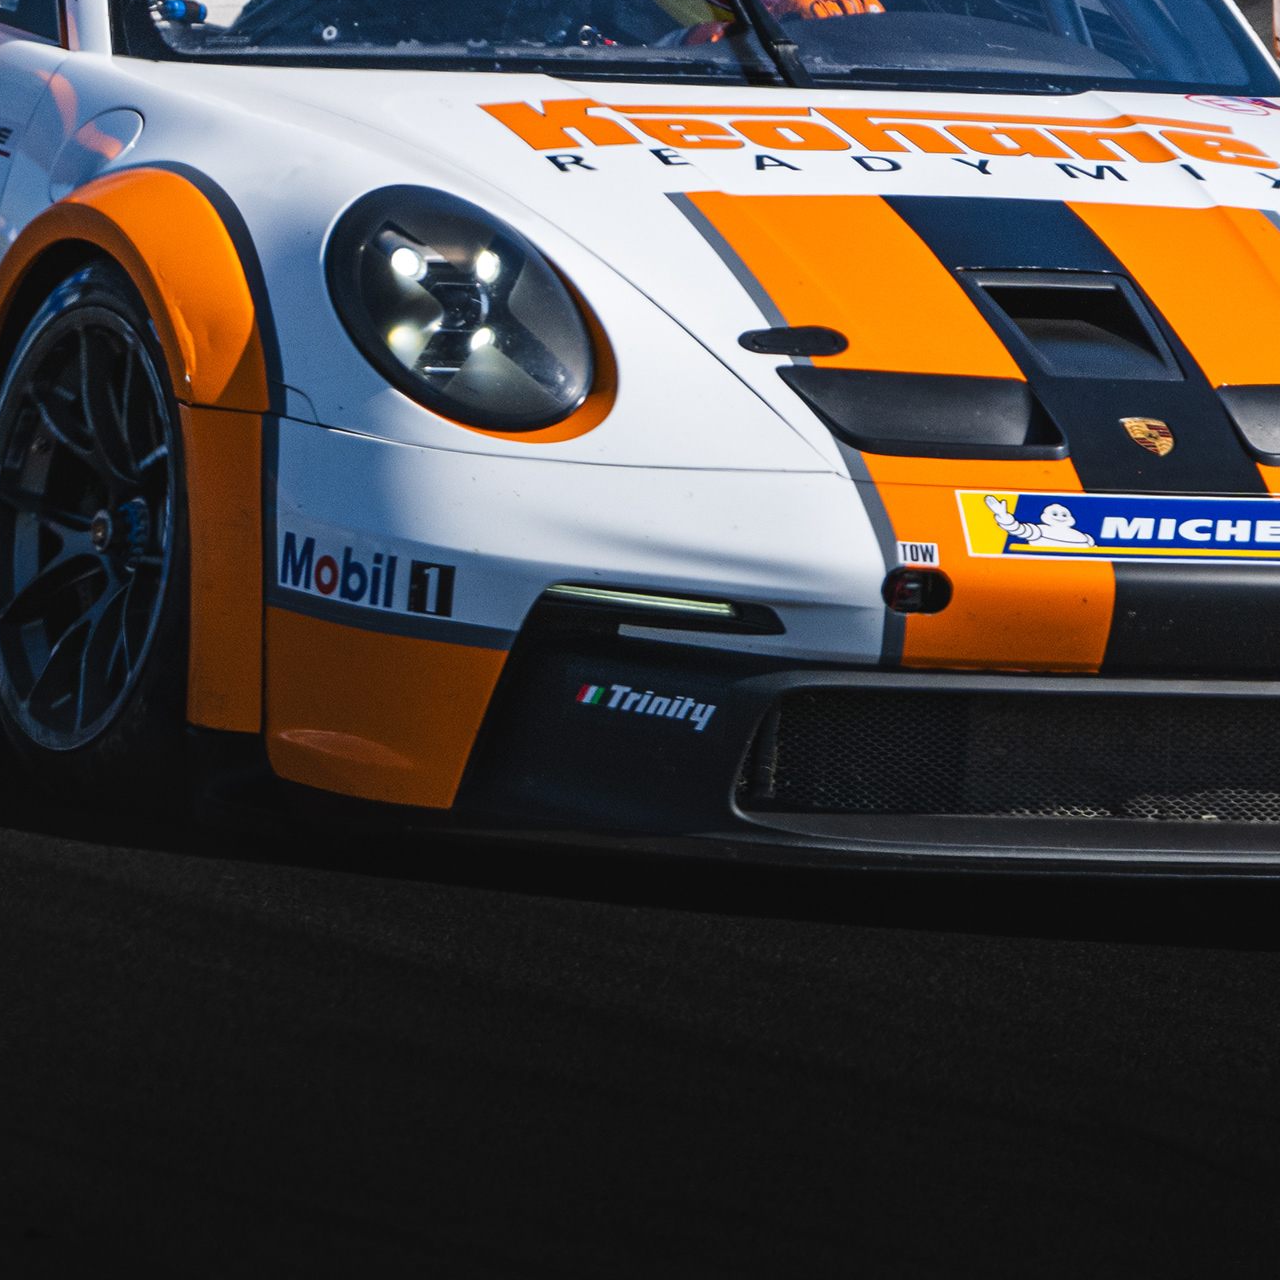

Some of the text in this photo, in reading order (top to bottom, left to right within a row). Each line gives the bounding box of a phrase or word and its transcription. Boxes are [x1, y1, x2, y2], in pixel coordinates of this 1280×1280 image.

[279, 531, 442, 613] Mobil 1
[900, 544, 935, 565] TOW
[605, 683, 717, 732] Trinity
